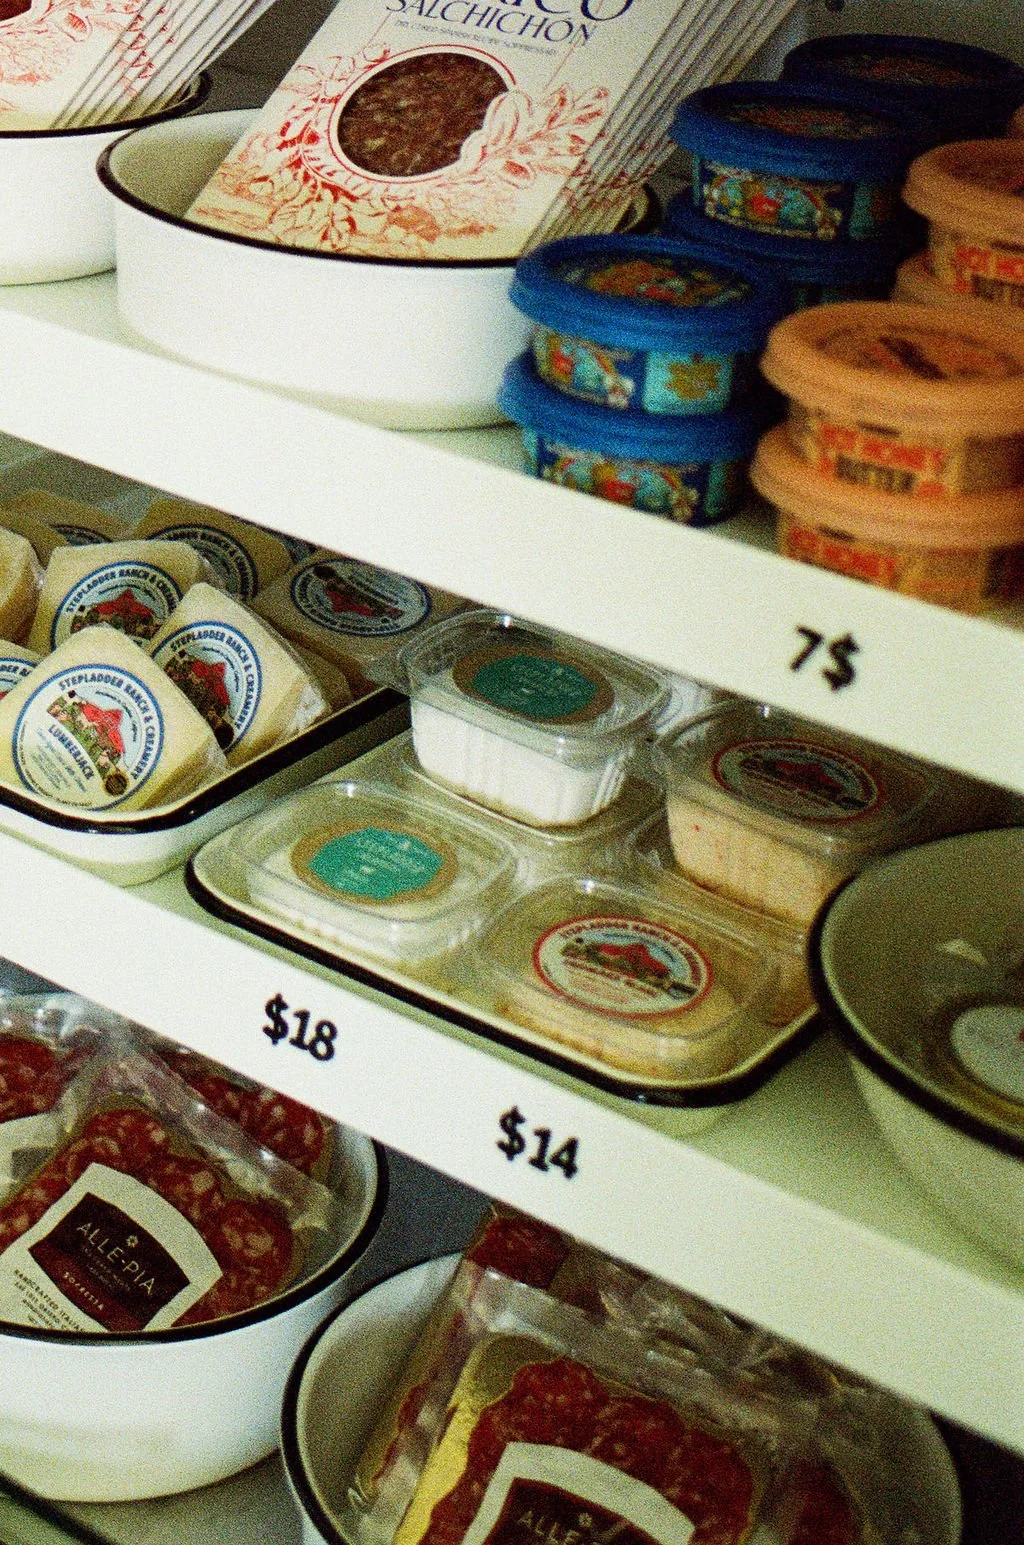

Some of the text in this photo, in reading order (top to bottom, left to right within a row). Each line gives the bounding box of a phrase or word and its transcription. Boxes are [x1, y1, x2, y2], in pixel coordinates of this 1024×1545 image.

[170, 628, 226, 651] STEPLADDER
[790, 626, 860, 692] 7$
[58, 672, 124, 691] STEPLADDER
[123, 681, 151, 717] RANCH
[48, 723, 95, 780] LUMBERJACK
[130, 725, 156, 780] CREAMERY
[262, 994, 338, 1061] $18
[498, 1106, 579, 1181] $14
[76, 1222, 157, 1297] ALLE-PIA
[517, 1510, 581, 1545] ALLE
